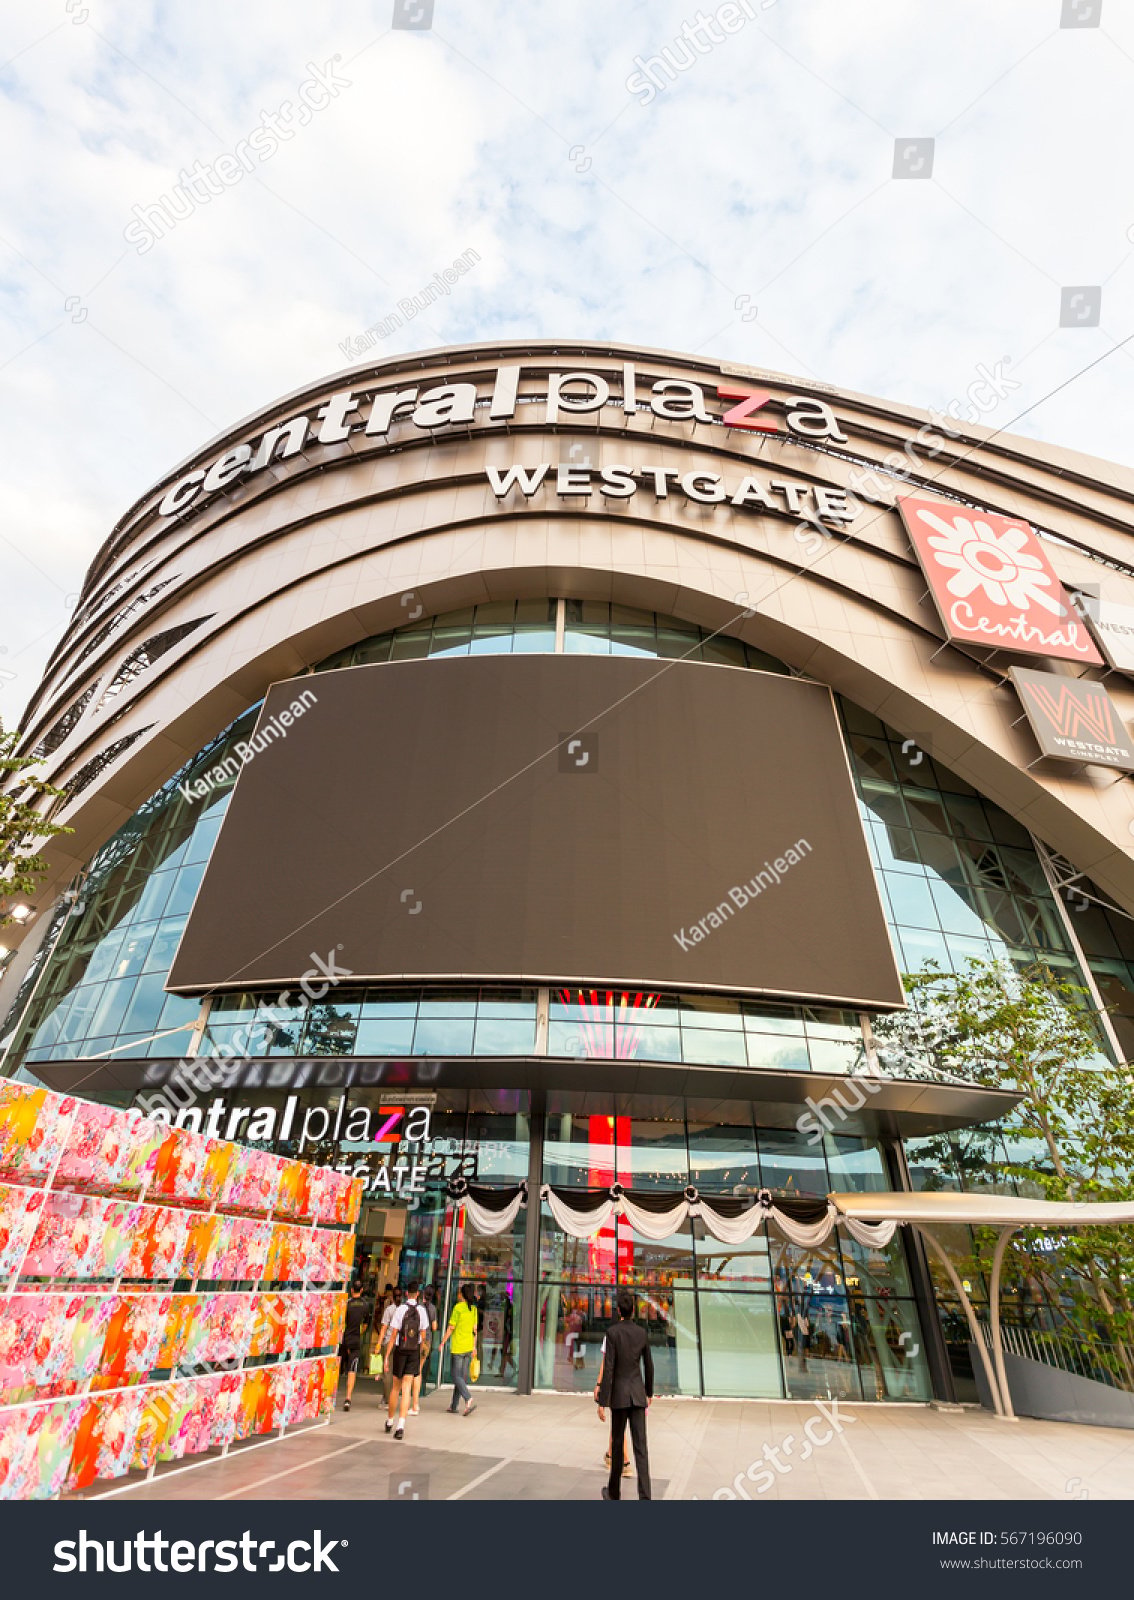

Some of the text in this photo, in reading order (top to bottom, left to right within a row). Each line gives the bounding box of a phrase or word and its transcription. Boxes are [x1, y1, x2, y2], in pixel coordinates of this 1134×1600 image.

[484, 463, 857, 523] WESTGATE
[951, 601, 1089, 652] Central
[1053, 736, 1130, 758] WESTGATE
